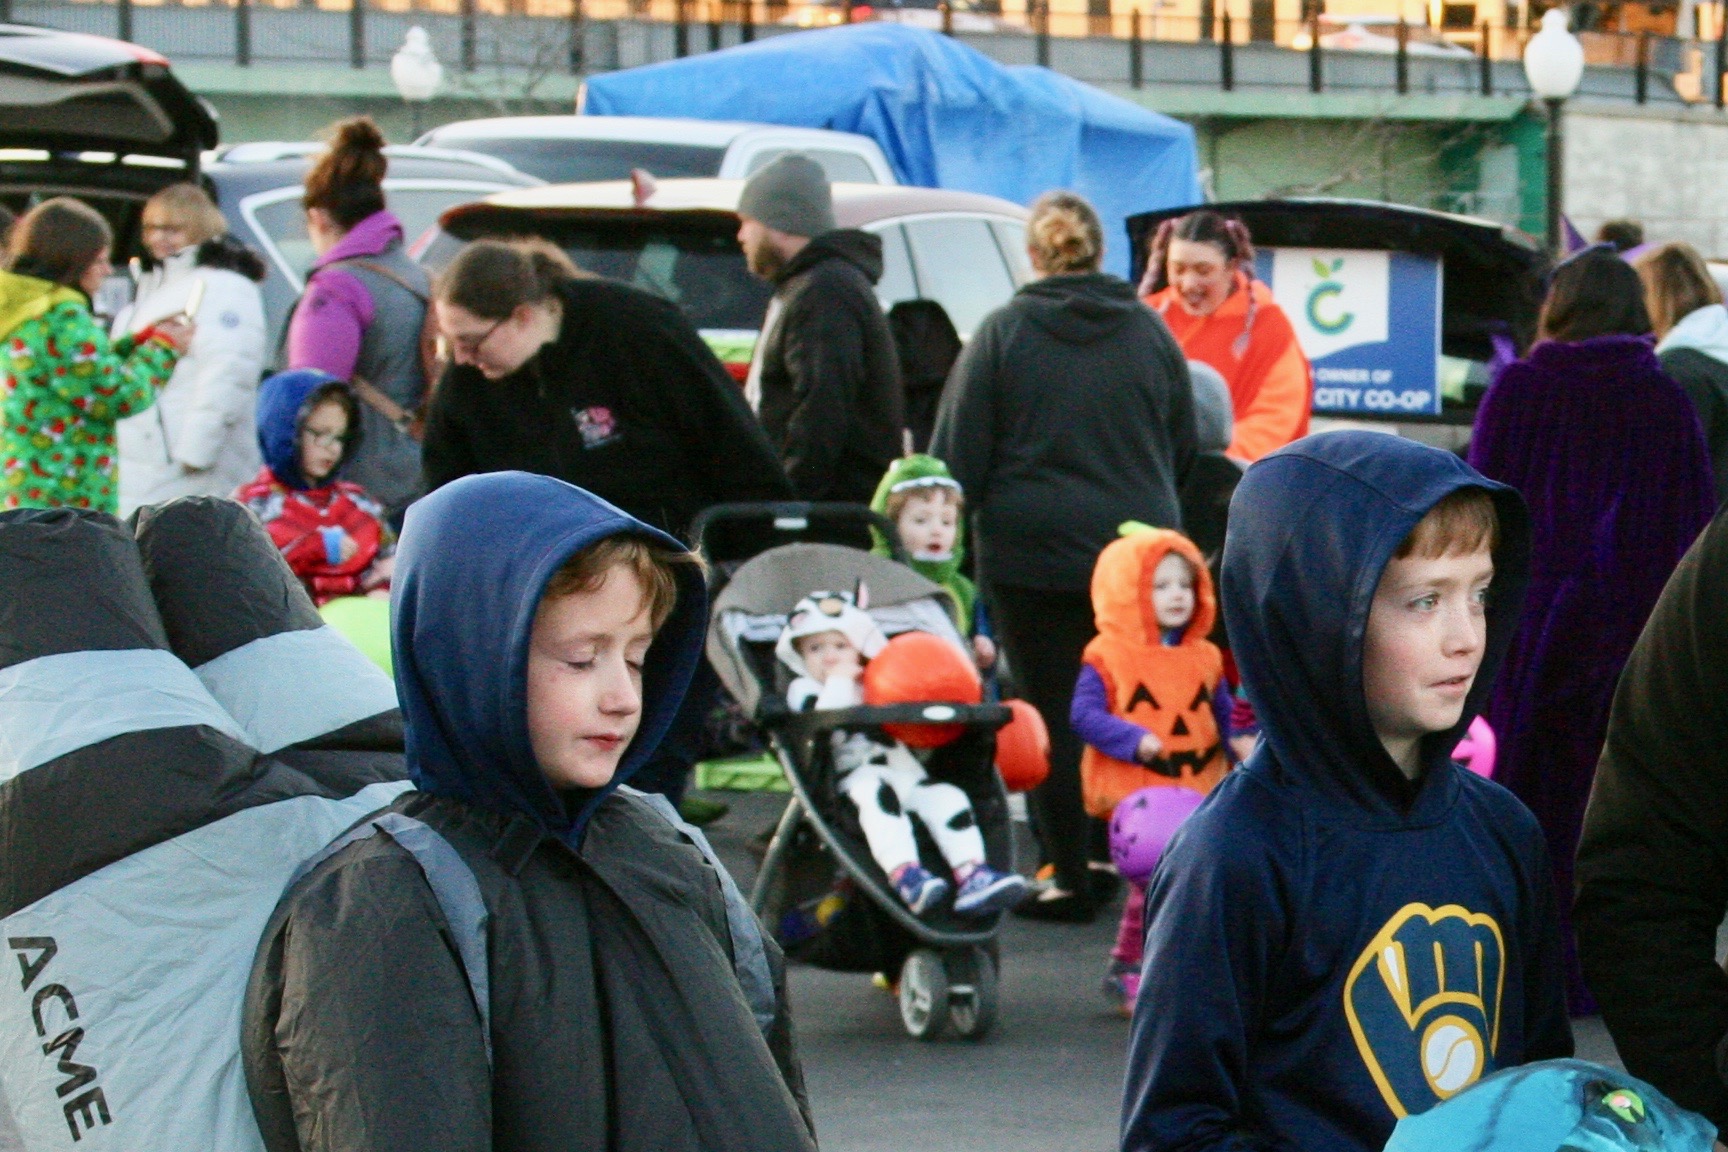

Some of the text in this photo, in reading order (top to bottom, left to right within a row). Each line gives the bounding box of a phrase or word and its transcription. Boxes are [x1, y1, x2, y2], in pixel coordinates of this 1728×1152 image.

[1315, 368, 1393, 384] OWNER OF
[1314, 387, 1431, 410] CITY CO-OP
[8, 936, 112, 1142] ACME
